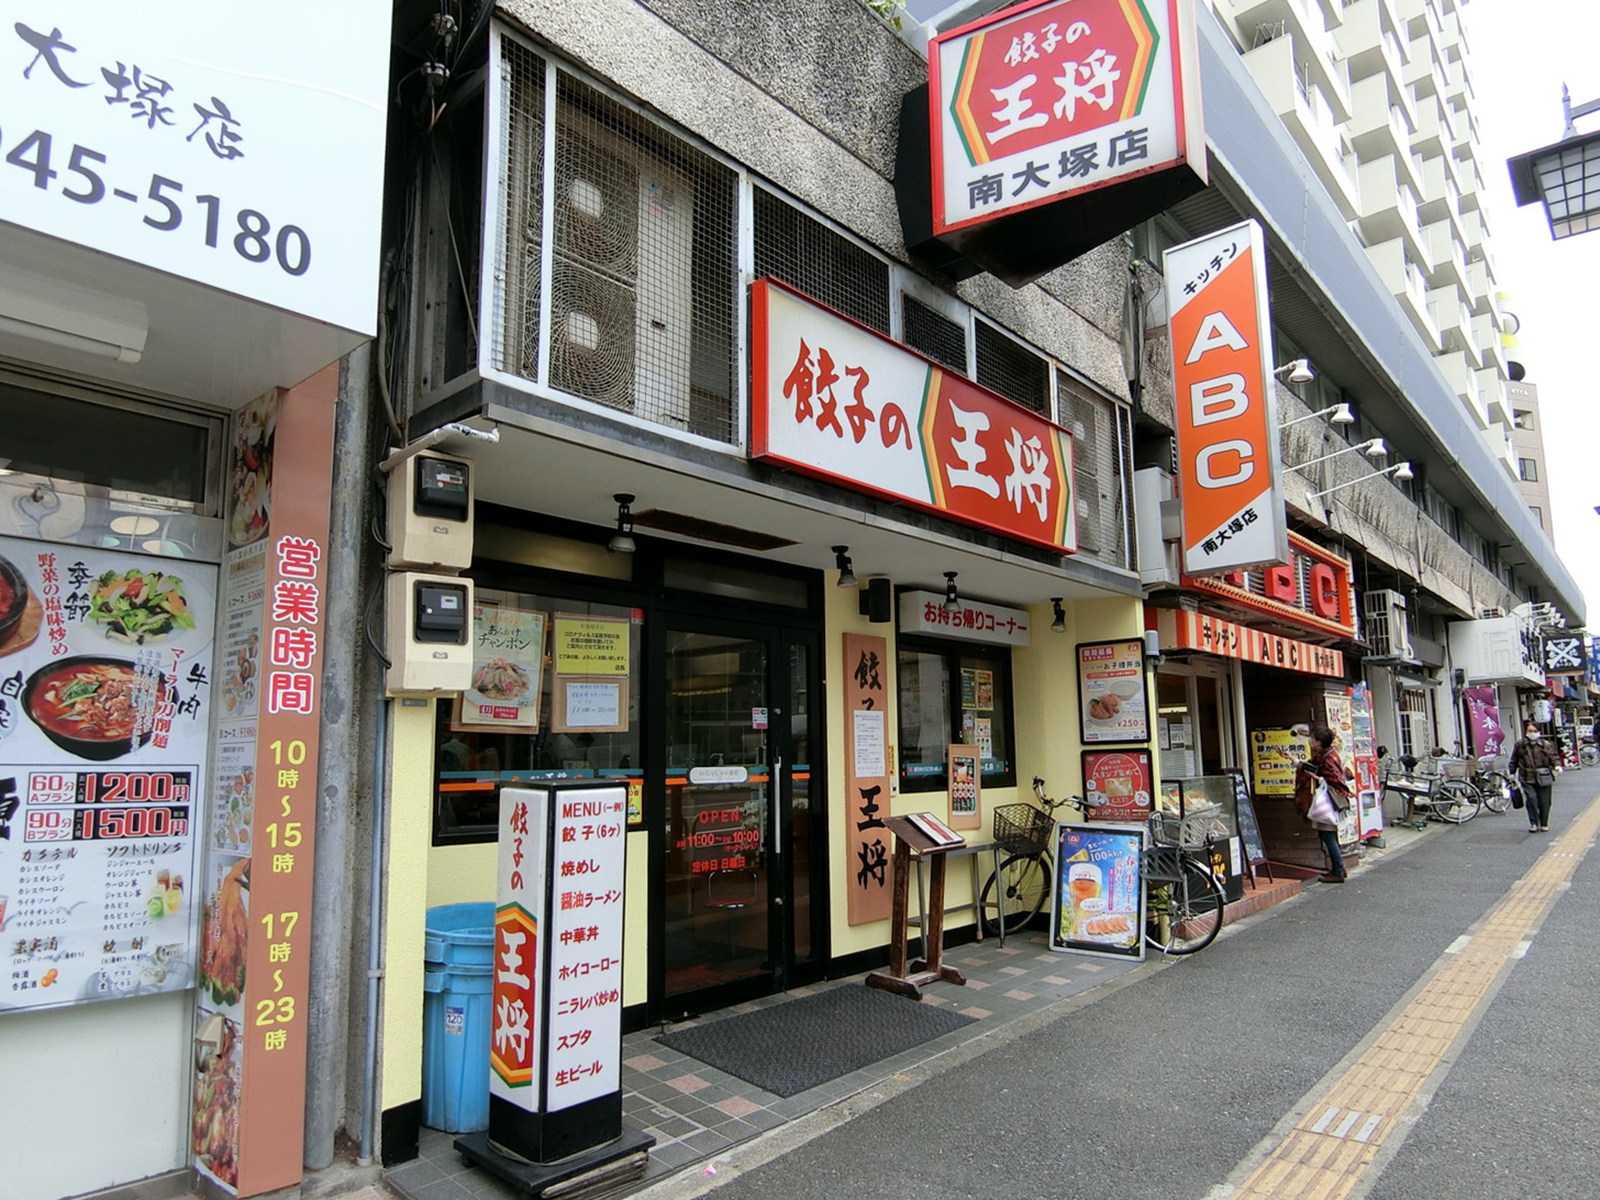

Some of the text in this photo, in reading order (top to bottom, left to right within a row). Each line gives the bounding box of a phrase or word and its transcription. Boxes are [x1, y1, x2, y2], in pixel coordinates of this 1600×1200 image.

[1004, 21, 1091, 67] 餃子の
[14, 22, 245, 160] 大塚店
[985, 48, 1122, 145] 王将
[967, 127, 1149, 209] 南大塚店
[0, 126, 311, 277] 45-5180
[1183, 242, 1238, 296] キッチン
[1184, 310, 1255, 490] ABC
[783, 336, 1052, 523] 餃子の 王将
[1200, 506, 1259, 556] 南大塚店
[64, 561, 95, 622] 季節
[38, 553, 68, 656] 野菜の塩味炒め
[268, 535, 320, 715] 営業時間
[924, 601, 1027, 635] お持ち帰りコーナー
[478, 633, 531, 650] チャンポン
[1203, 623, 1239, 650] キッチン
[1262, 637, 1297, 666] ABC
[152, 647, 185, 749] マーラー刀削麺
[178, 662, 209, 721] 牛肉
[32, 775, 74, 791] 60分
[30, 793, 73, 802] Aプラン
[562, 801, 602, 818] MENU
[29, 812, 72, 828] 90分
[700, 810, 739, 823] OPEN
[27, 830, 70, 839] Bプラン
[732, 830, 759, 842] 10:00
[857, 785, 888, 890] 王将
[107, 842, 182, 857] ソフトドリンク
[20, 864, 61, 873] カシスソーダ
[561, 859, 600, 877] 焼めし
[692, 856, 745, 873] 定休日 日曜日
[19, 874, 65, 884] カシスオレンジ
[105, 879, 138, 888] ウーロン茶
[104, 902, 129, 910] カルピス
[105, 889, 142, 899] ジャスミン茶
[561, 889, 621, 910] 醤油ラーメン
[495, 801, 530, 1063] 餃子の 王将
[560, 925, 599, 946] 中華丼
[558, 957, 620, 980] ホイコーロー
[557, 988, 620, 1016] ニラレバ炒め
[556, 1029, 592, 1051] スブタ
[555, 1060, 604, 1087] 生ビール
